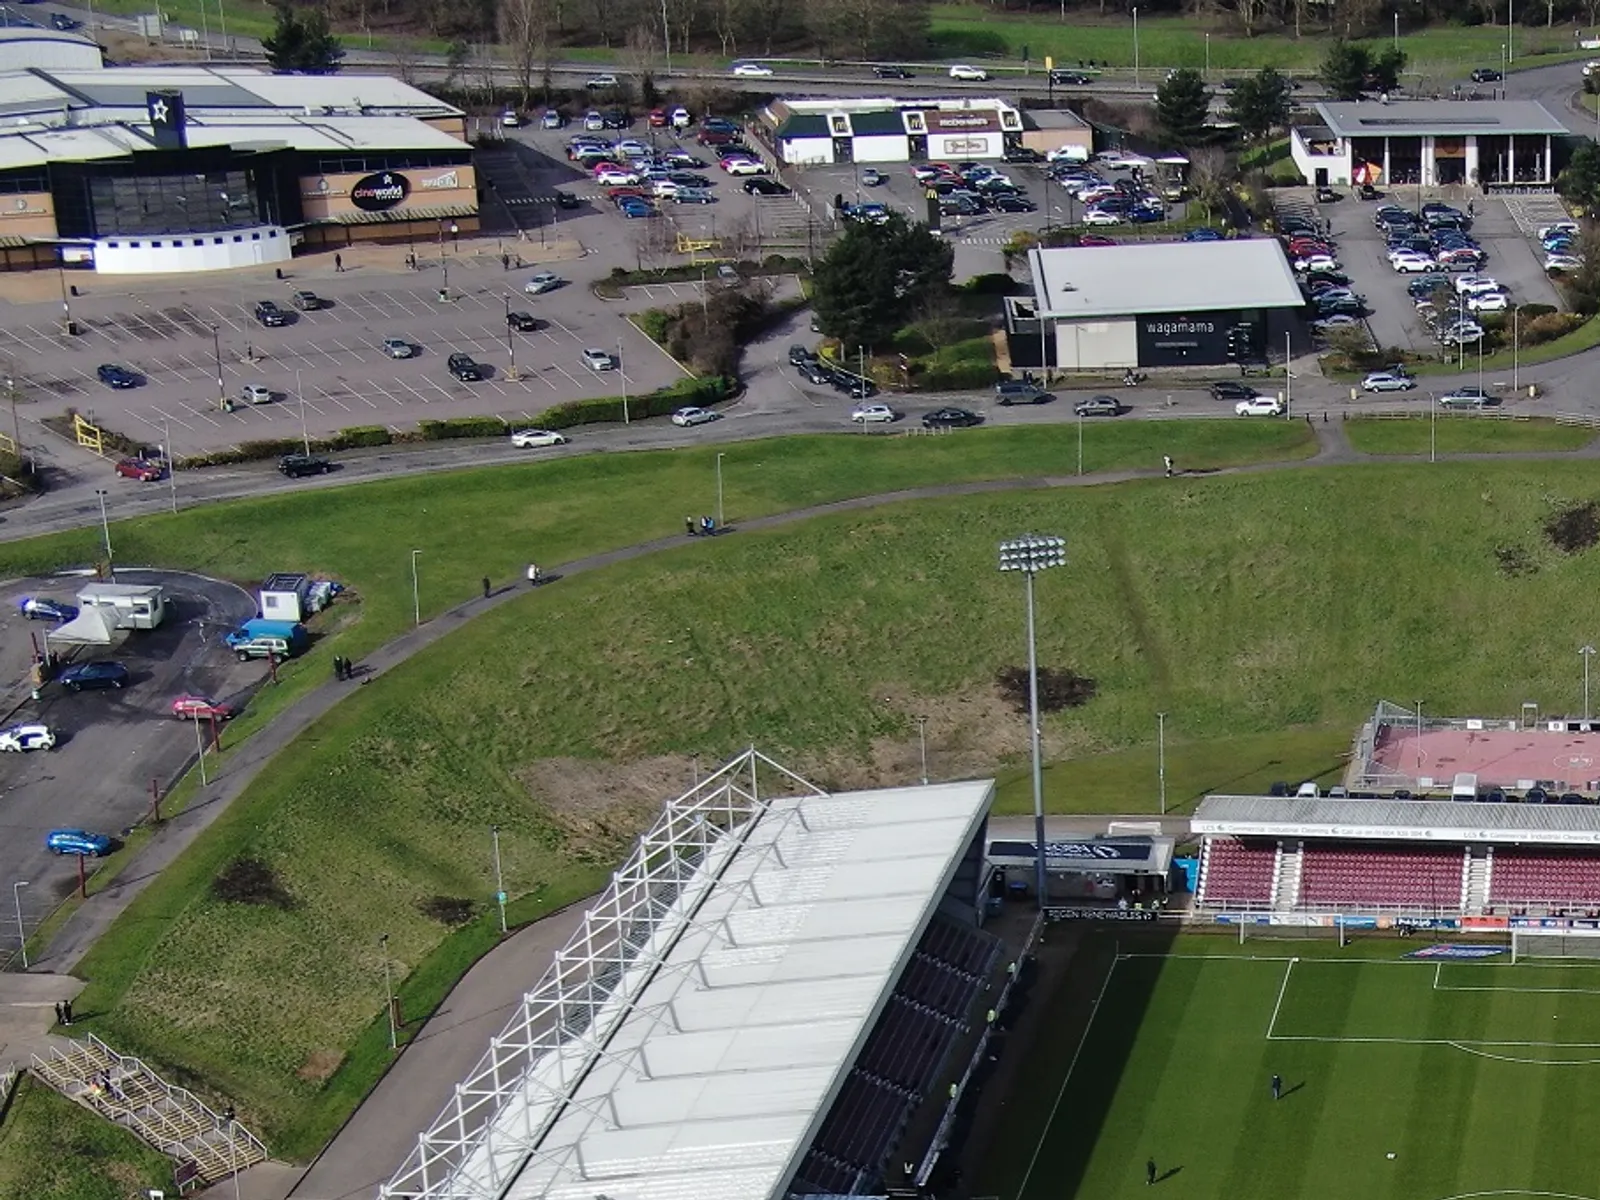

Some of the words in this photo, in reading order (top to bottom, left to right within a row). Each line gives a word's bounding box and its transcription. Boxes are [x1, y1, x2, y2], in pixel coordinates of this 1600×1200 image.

[354, 185, 403, 199] cineworld
[1146, 322, 1214, 336] wagamama
[1268, 826, 1299, 834] Industrial
[1301, 827, 1329, 835] Cleaning
[1490, 832, 1527, 840] Commercial
[1563, 834, 1591, 842] Cleaning
